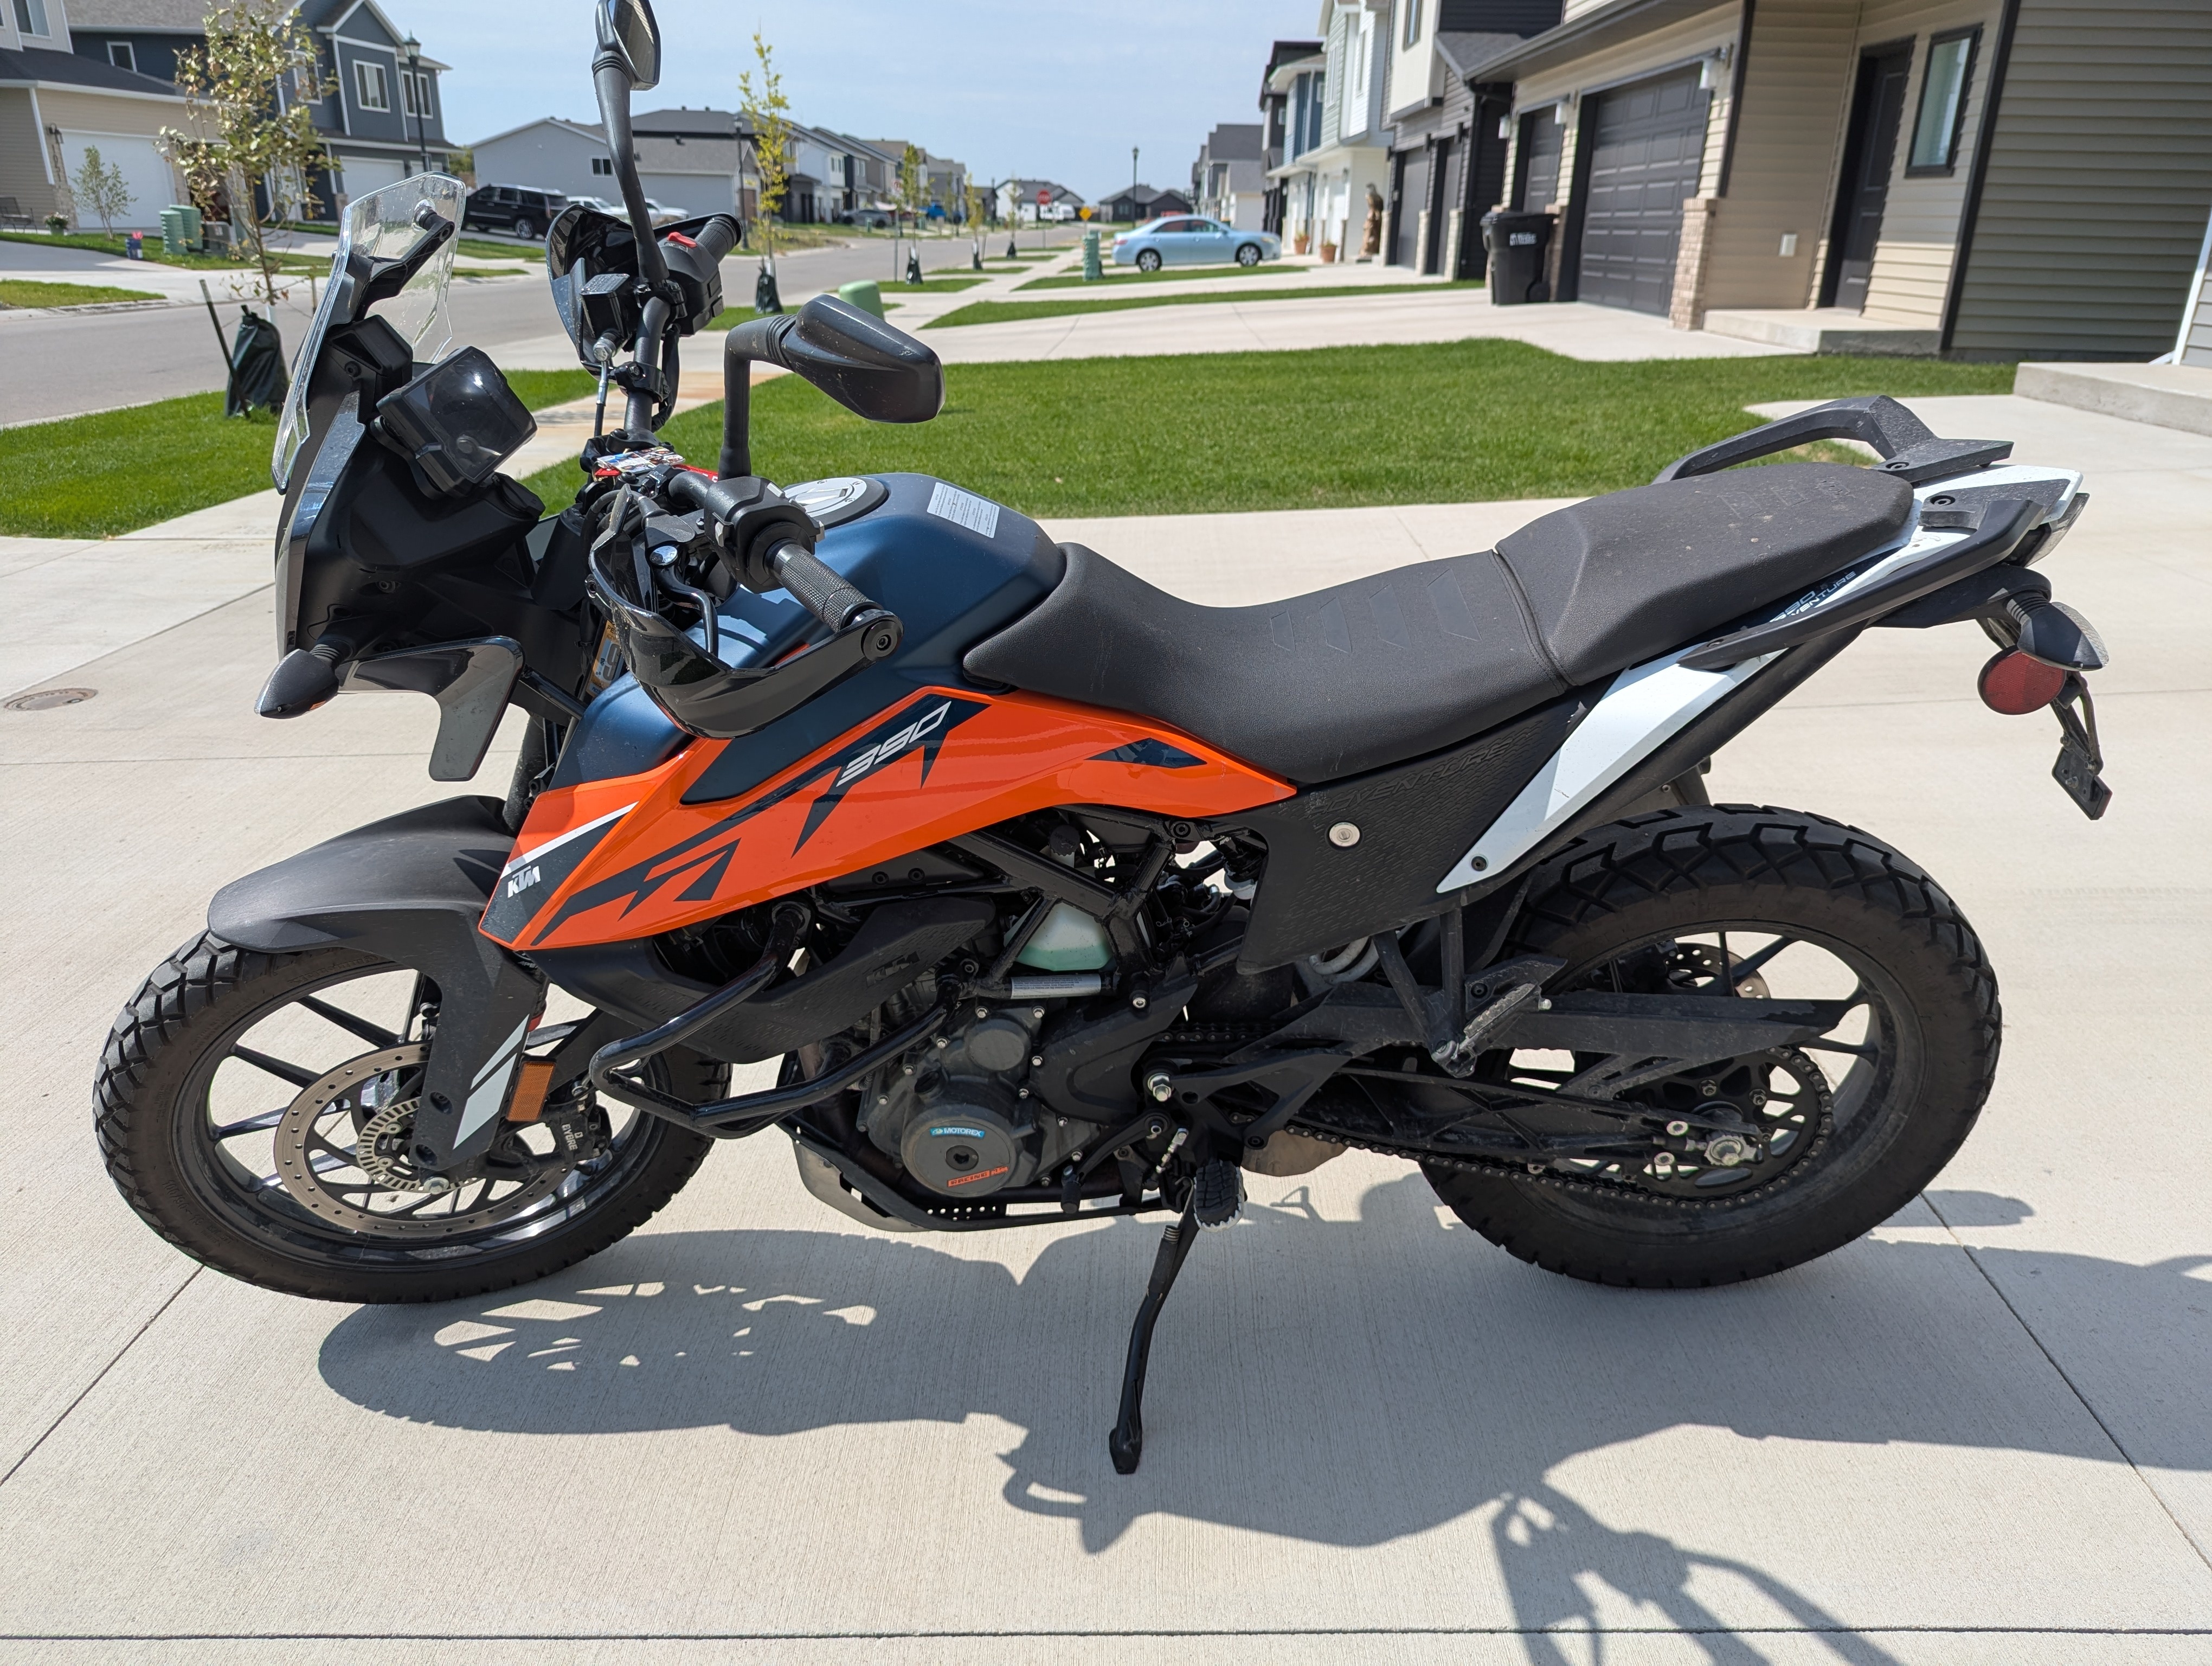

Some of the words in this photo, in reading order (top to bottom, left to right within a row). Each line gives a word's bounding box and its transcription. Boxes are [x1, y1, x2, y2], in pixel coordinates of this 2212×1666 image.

[1789, 571, 1856, 617] VENTURE
[836, 701, 951, 787] 390
[507, 865, 541, 898] KTM
[943, 1126, 983, 1137] MOTOREX
[950, 1171, 988, 1185] RACING
